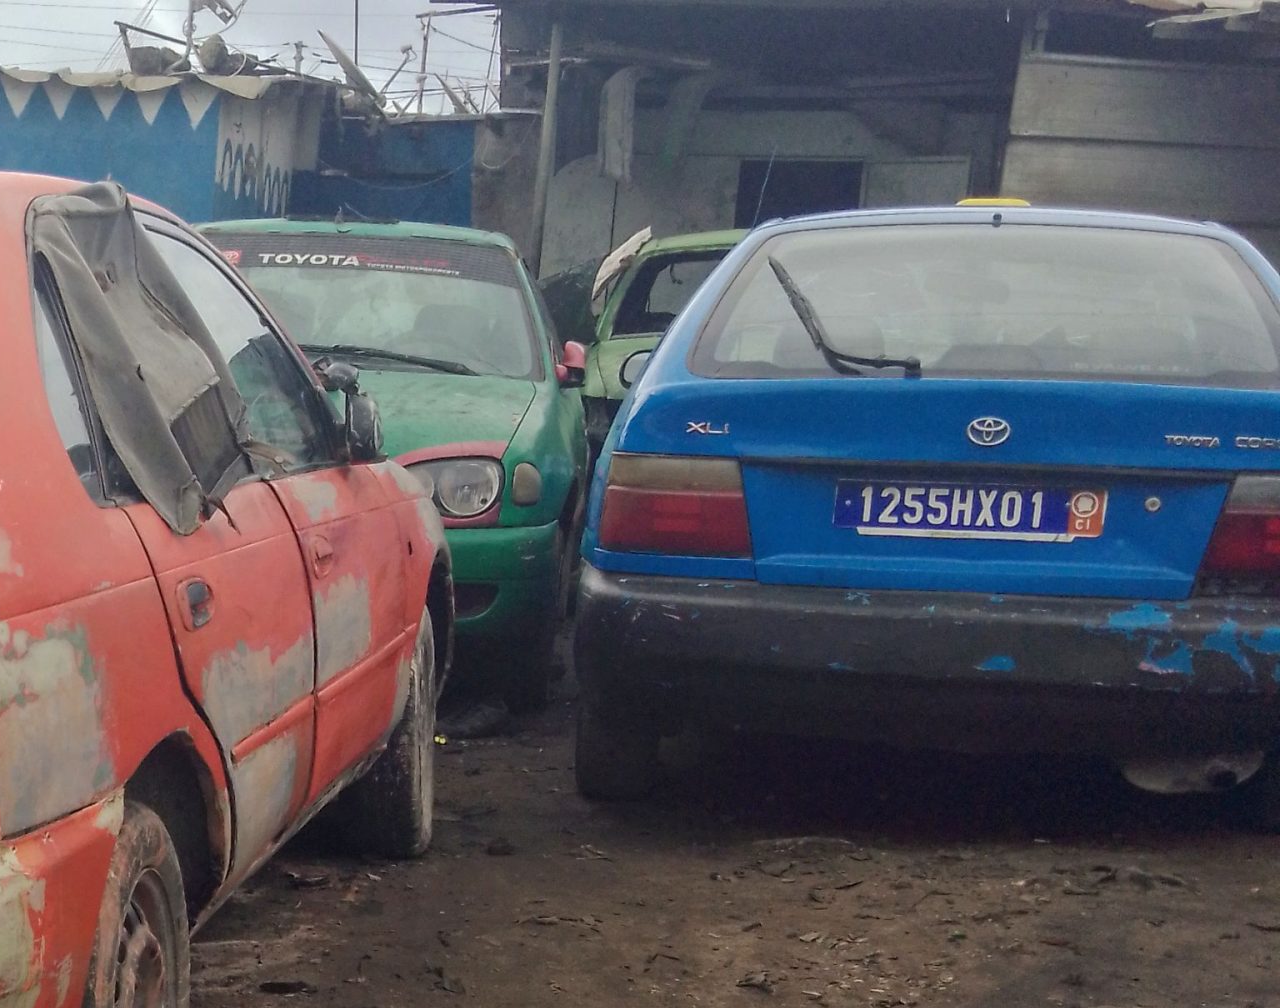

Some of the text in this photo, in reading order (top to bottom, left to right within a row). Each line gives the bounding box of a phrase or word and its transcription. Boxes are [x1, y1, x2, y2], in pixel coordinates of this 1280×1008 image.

[258, 253, 360, 266] TOYOTA
[1164, 434, 1220, 448] TOYOTA
[861, 486, 1043, 529] 1255HX01
[1075, 519, 1090, 530] CI
